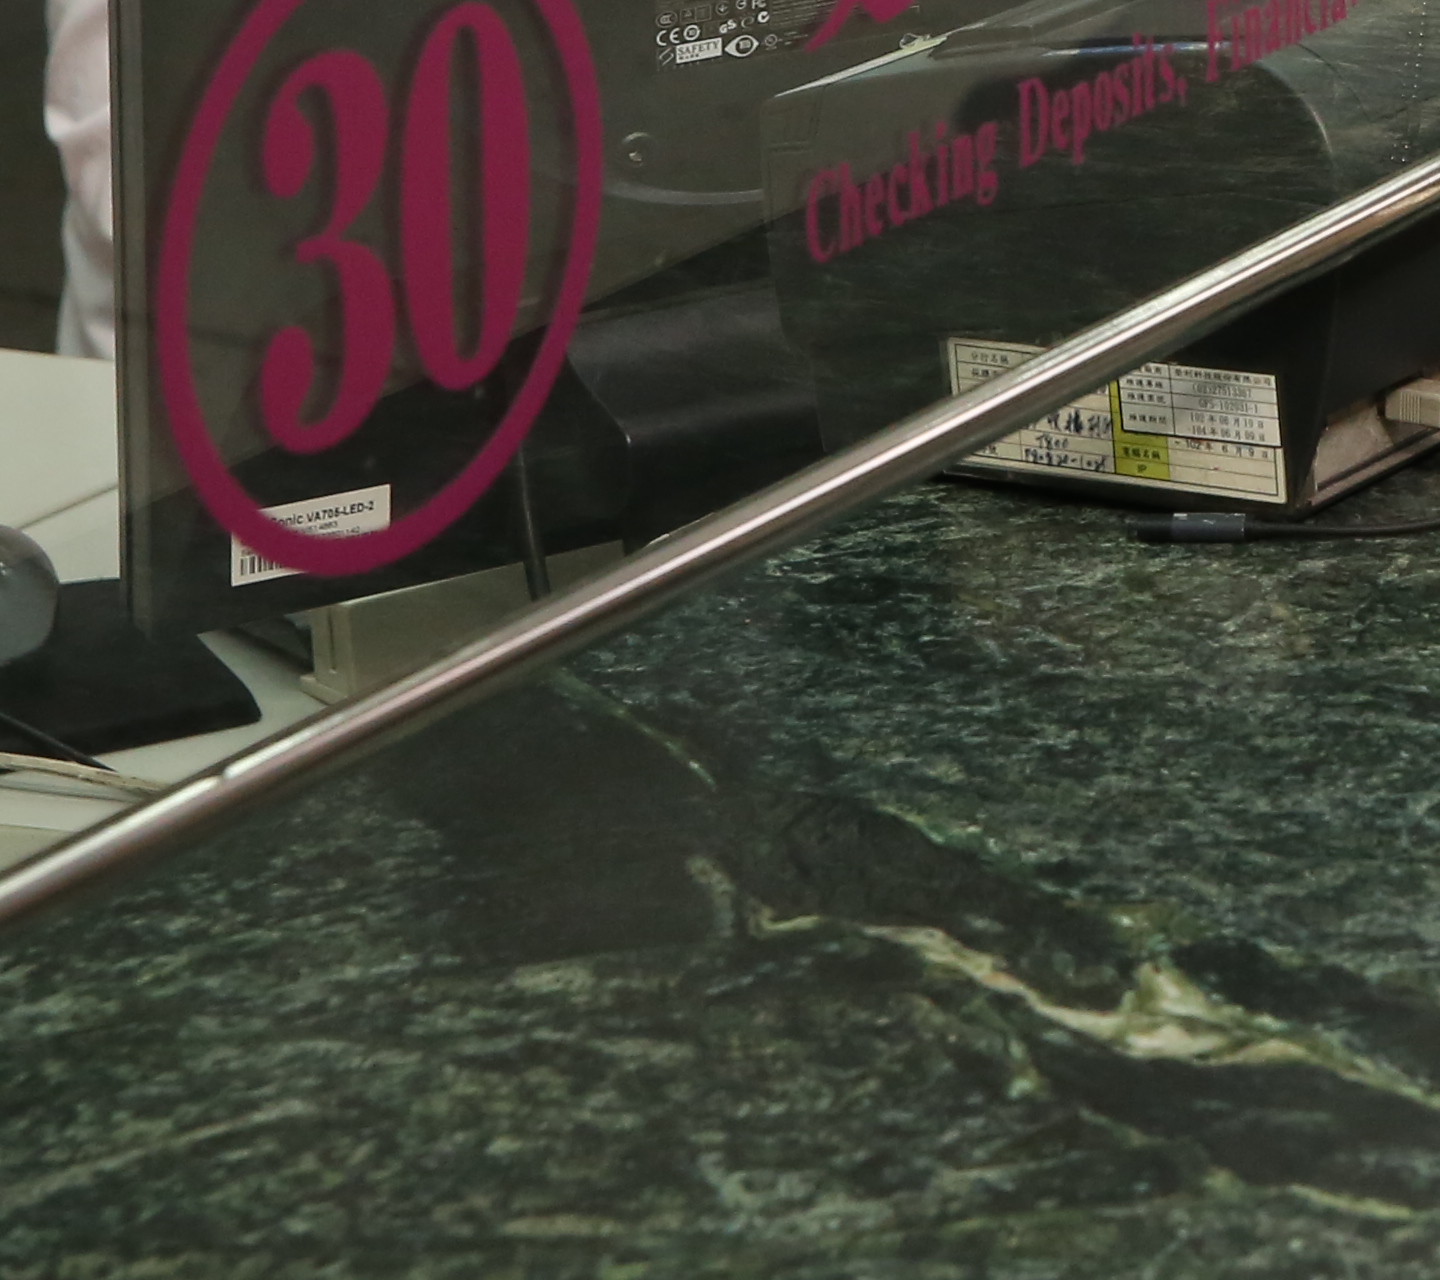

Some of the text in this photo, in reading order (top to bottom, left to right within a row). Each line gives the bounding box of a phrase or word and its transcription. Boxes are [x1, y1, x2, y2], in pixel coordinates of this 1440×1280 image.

[677, 40, 720, 55] SAFETY
[806, 121, 999, 264] Checking
[1017, 31, 1189, 168] Deposits,
[262, 1, 531, 455] 30
